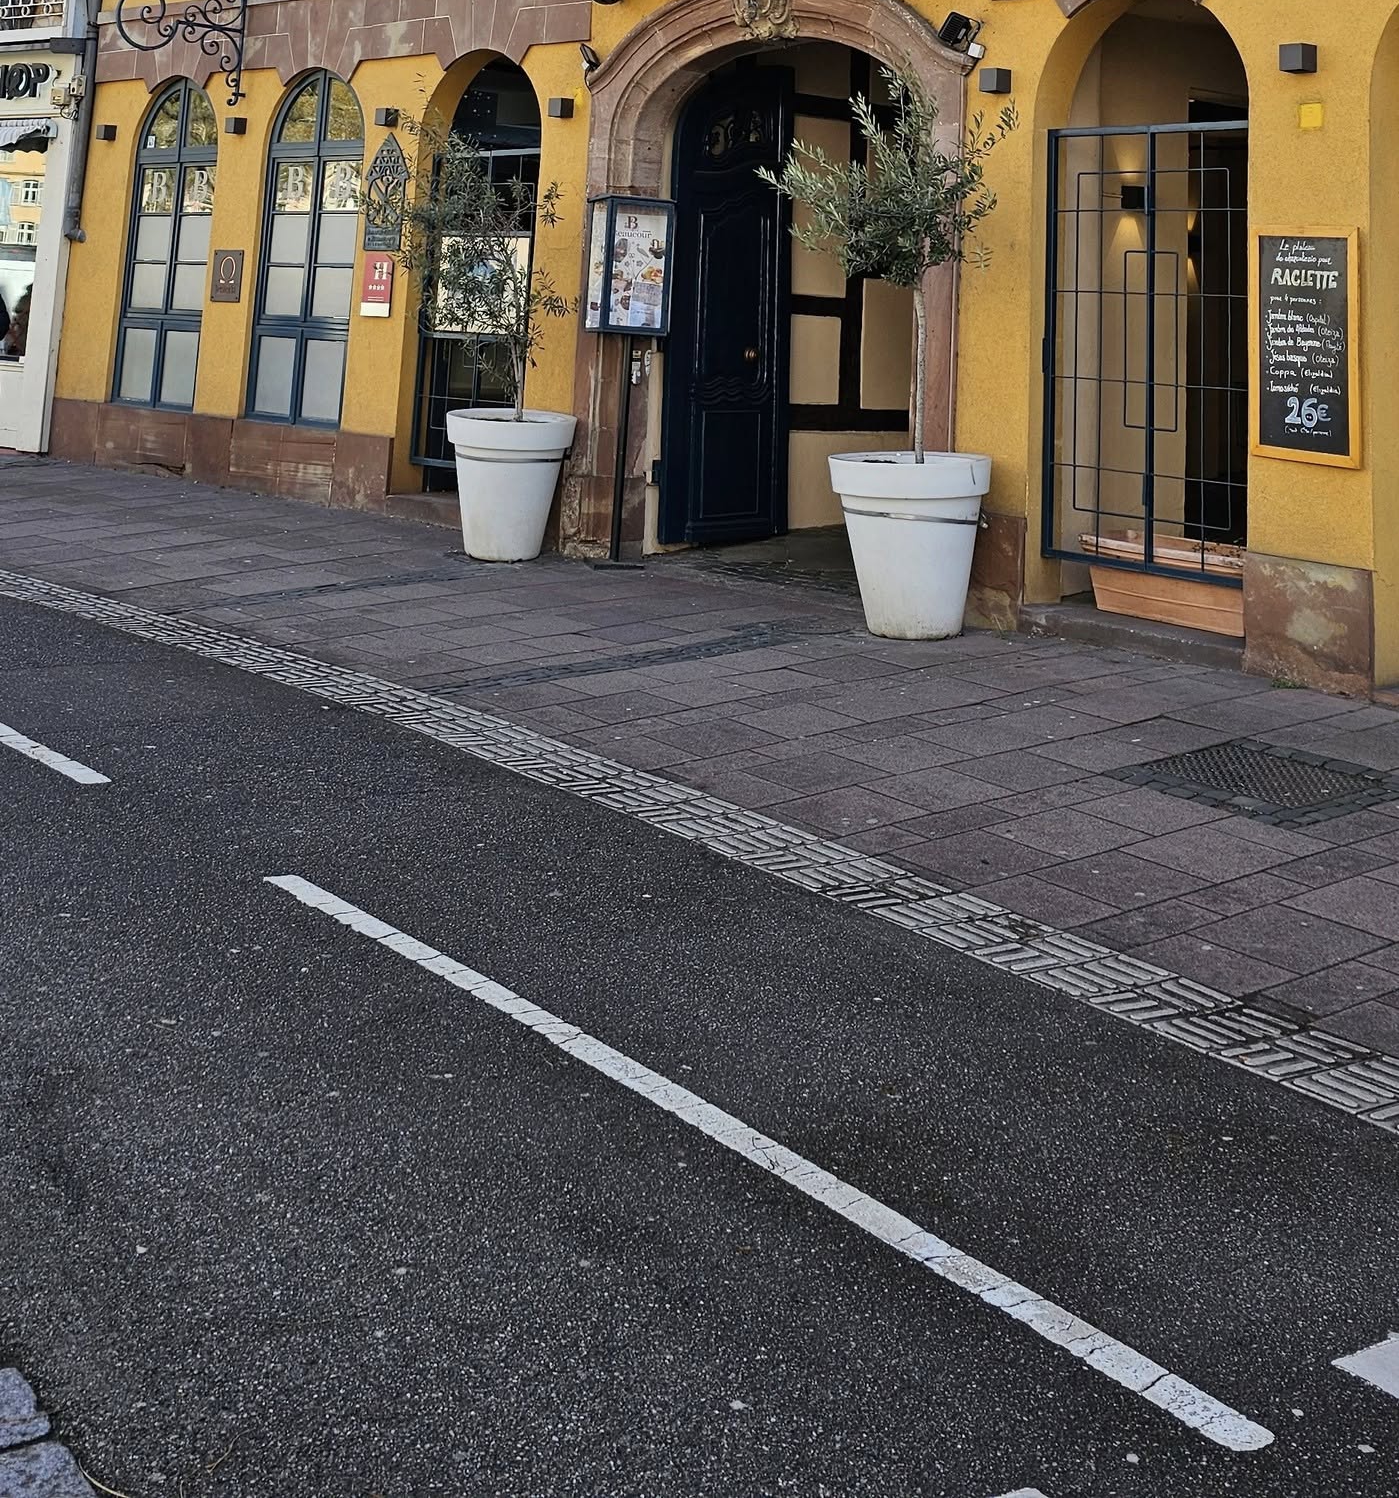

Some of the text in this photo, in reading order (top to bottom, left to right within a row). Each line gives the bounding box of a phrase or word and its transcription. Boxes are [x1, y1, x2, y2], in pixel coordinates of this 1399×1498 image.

[1270, 267, 1339, 290] RACLETTE
[1269, 365, 1297, 379] Coppa
[1284, 396, 1332, 428] 26€
